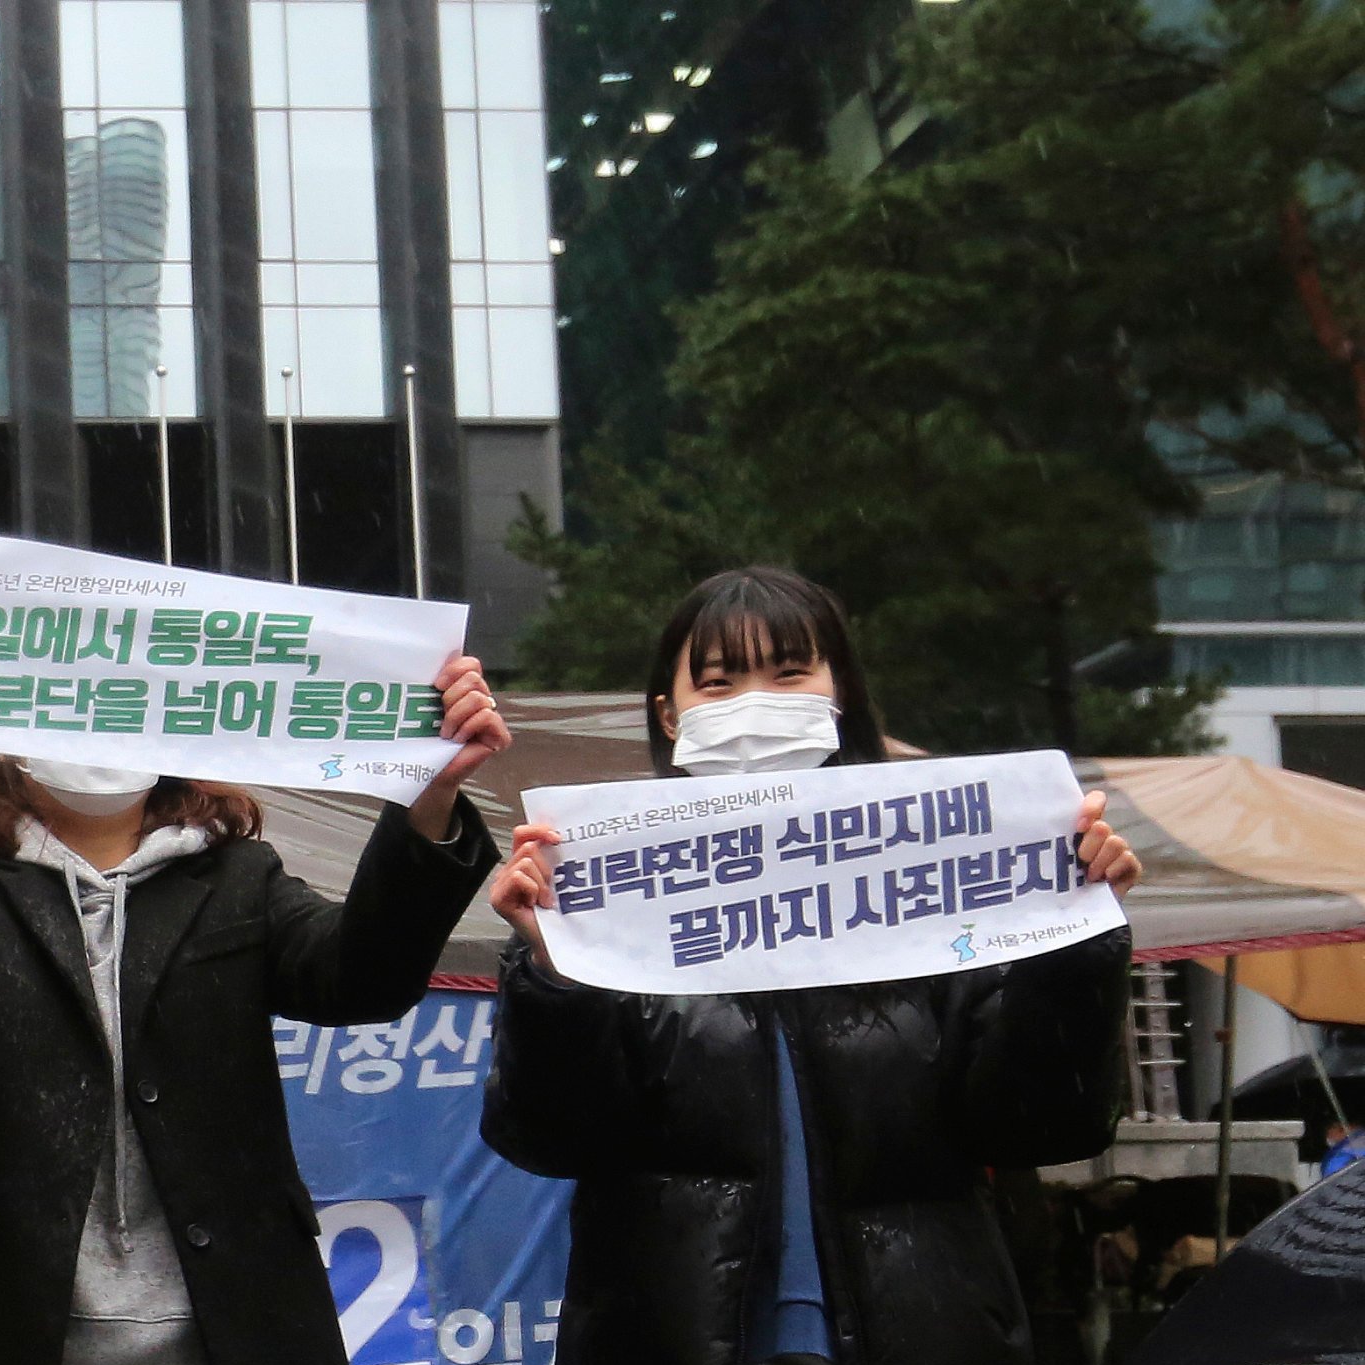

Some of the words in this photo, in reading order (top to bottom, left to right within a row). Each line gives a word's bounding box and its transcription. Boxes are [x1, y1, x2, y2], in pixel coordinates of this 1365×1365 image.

[24, 574, 187, 598] 온라인항일만세시위
[145, 608, 321, 677] 통일로,
[161, 677, 279, 738] 넘어
[578, 812, 641, 842] 102주년
[643, 783, 795, 828] 온라인항일만세시위
[554, 823, 765, 916] 침략전쟁
[775, 780, 994, 868] 식민지배
[669, 883, 833, 968] 끝까지
[986, 918, 1090, 949] 서울겨레하나
